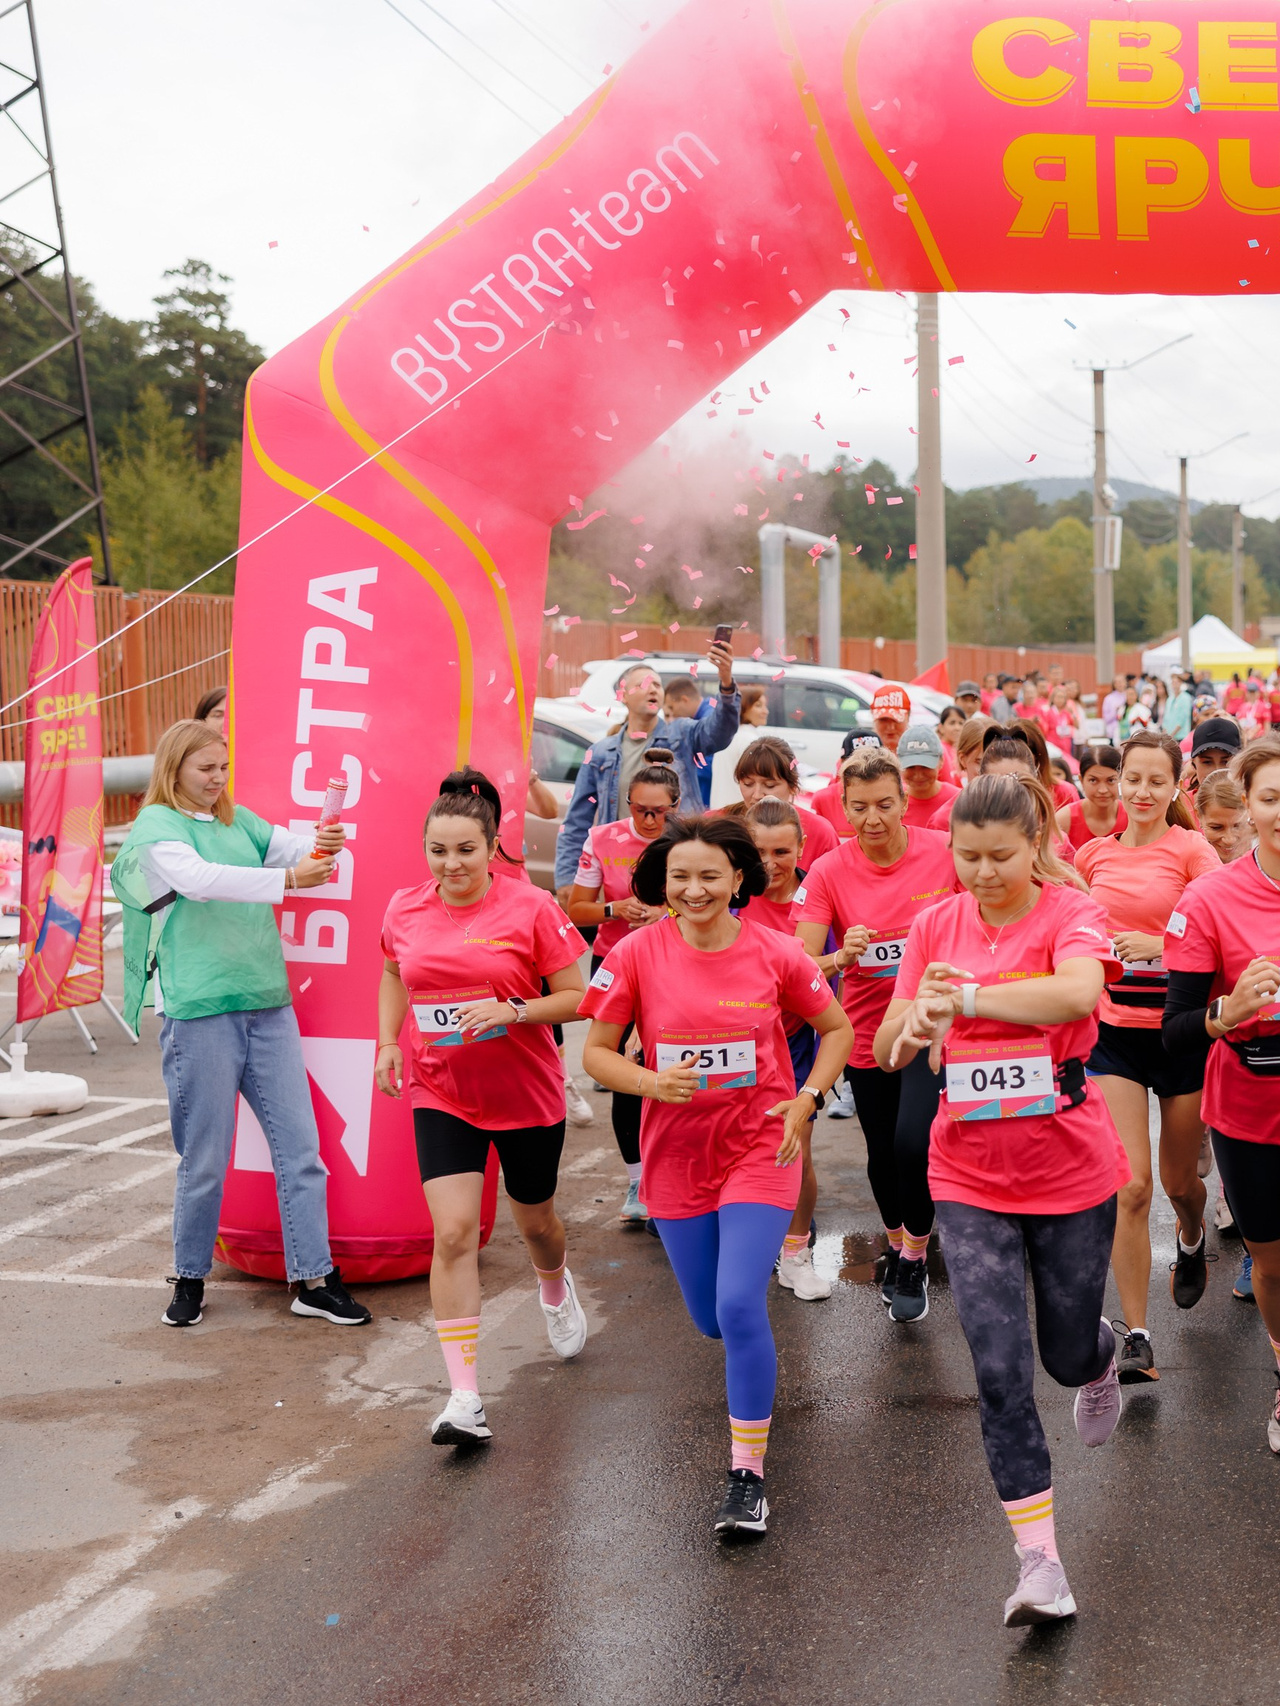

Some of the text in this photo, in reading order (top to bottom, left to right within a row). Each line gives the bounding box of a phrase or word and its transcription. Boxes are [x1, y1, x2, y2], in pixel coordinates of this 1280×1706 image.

[390, 130, 720, 405] BYSTRA team
[907, 741, 929, 751] FILA
[875, 944, 906, 961] 03
[433, 1007, 463, 1026] 05
[680, 1048, 729, 1069] 051
[971, 1065, 1026, 1092] 043
